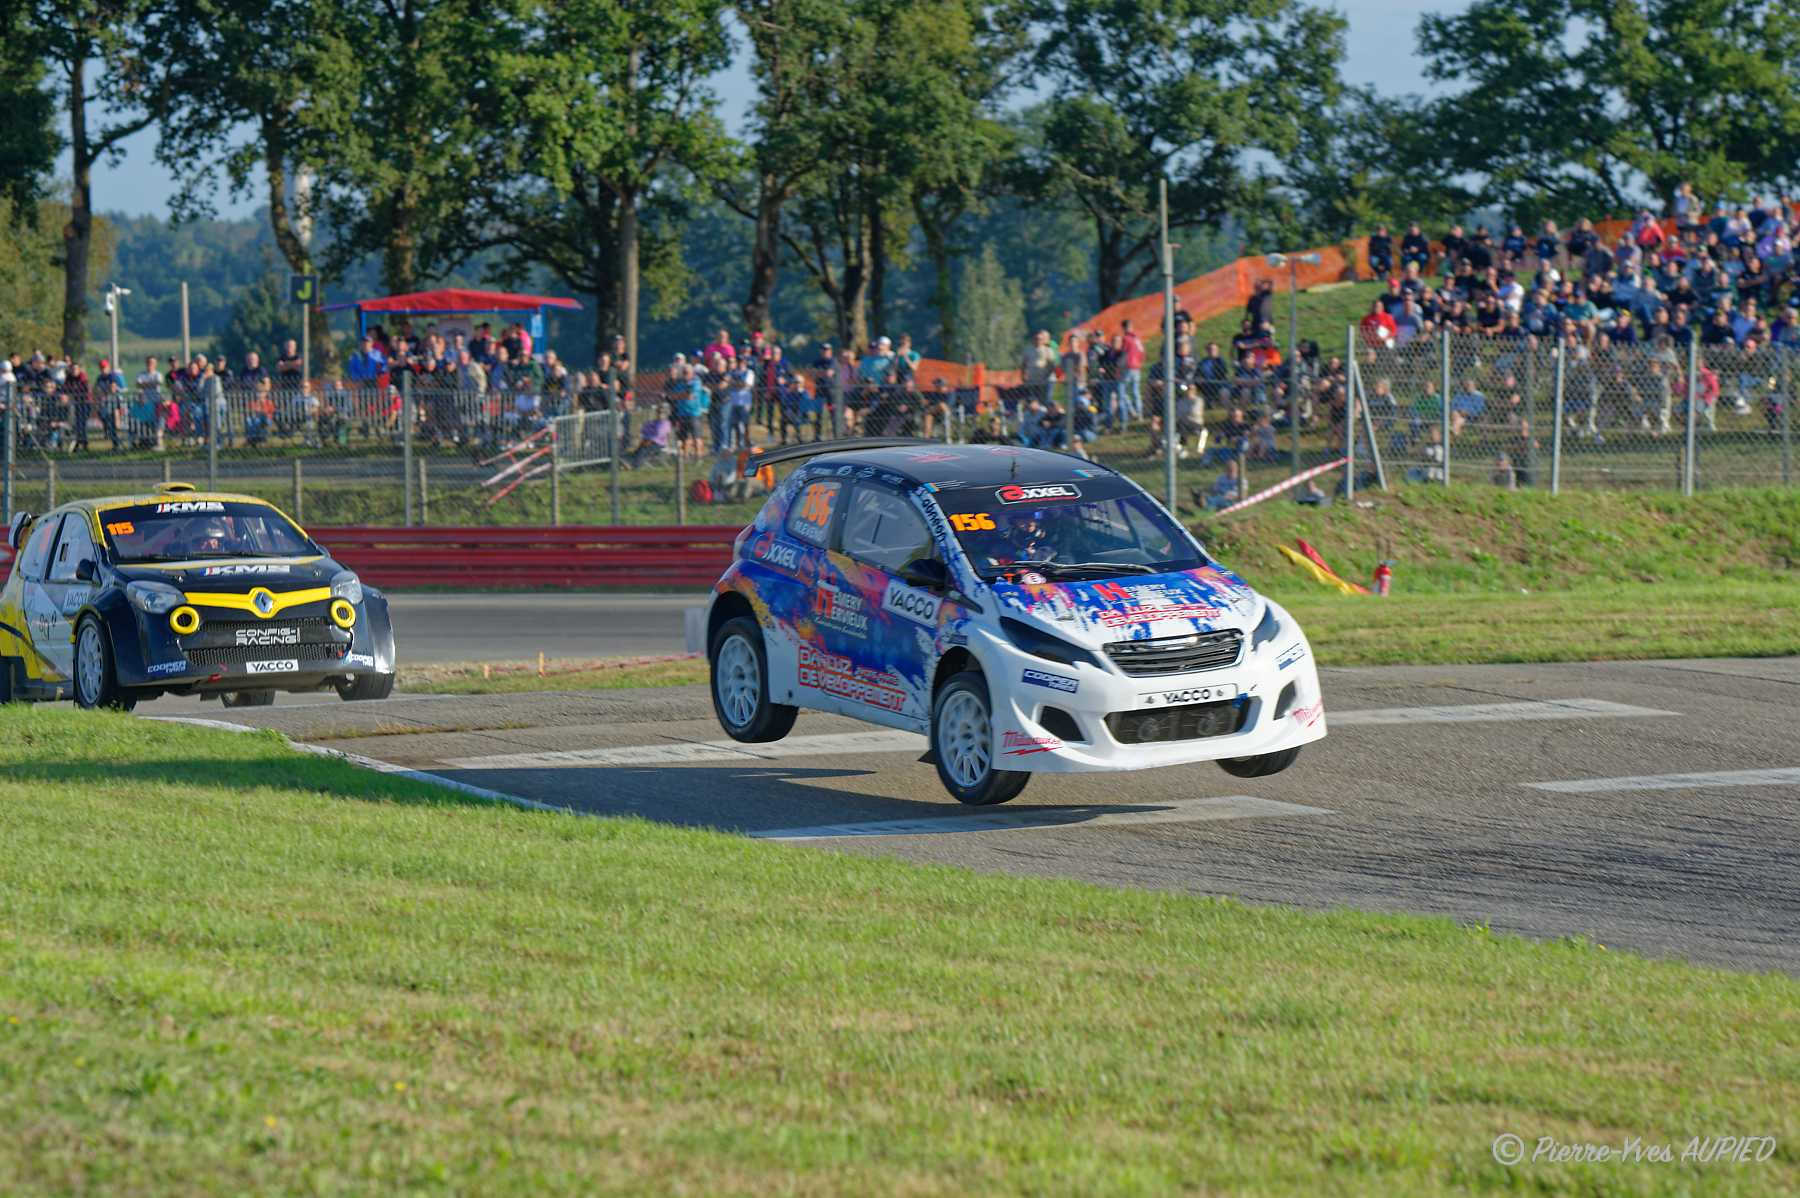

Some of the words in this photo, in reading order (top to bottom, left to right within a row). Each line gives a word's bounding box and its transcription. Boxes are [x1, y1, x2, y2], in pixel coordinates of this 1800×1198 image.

[296, 280, 312, 300] J
[107, 522, 134, 536] 115
[949, 513, 996, 531] 156
[889, 586, 935, 620] YACCO
[236, 635, 297, 646] RACING
[252, 661, 294, 671] YACCO
[1162, 688, 1211, 704] YACCO
